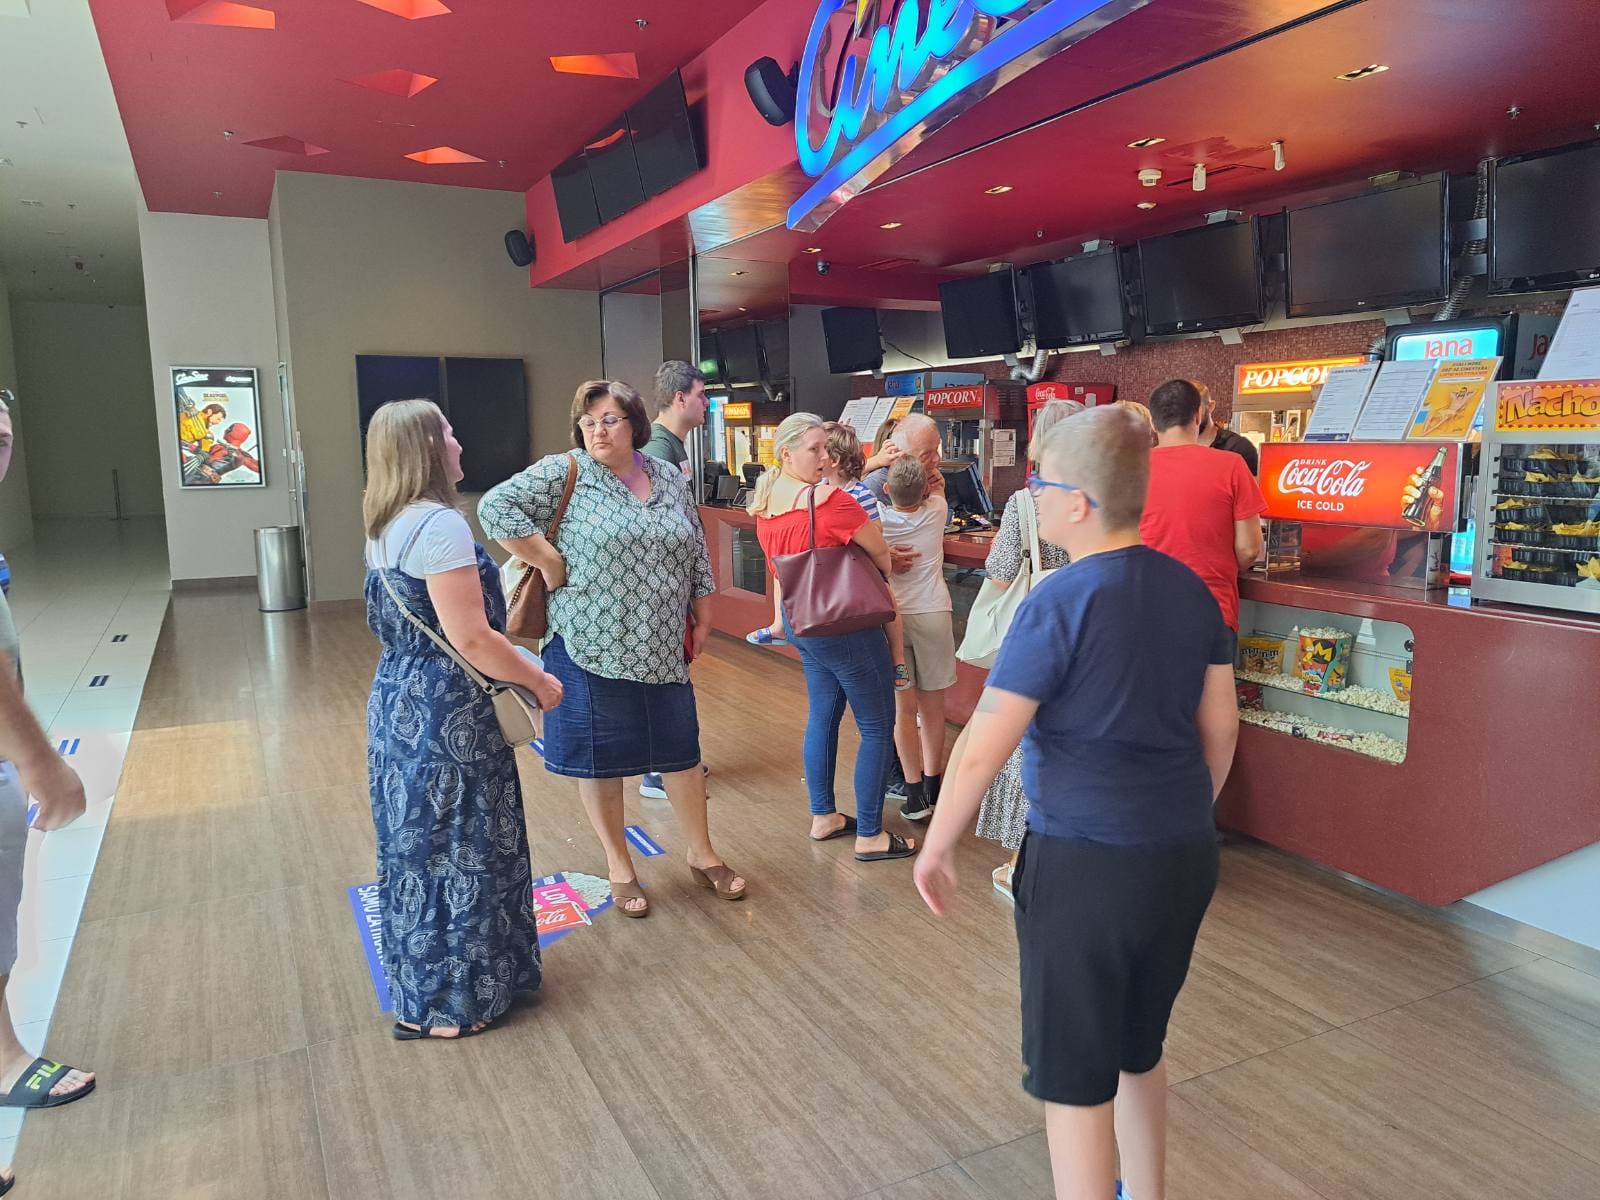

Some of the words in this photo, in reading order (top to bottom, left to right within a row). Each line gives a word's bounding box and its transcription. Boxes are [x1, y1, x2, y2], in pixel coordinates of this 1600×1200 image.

[1424, 338, 1473, 360] Jana
[1528, 334, 1552, 361] Ja
[927, 390, 978, 406] POPCORN
[1299, 458, 1328, 466] DRINK
[1277, 458, 1373, 498] Coca-Cola
[1296, 500, 1313, 510] ICE
[1315, 501, 1345, 512] COLD
[25, 1060, 65, 1090] FIL
